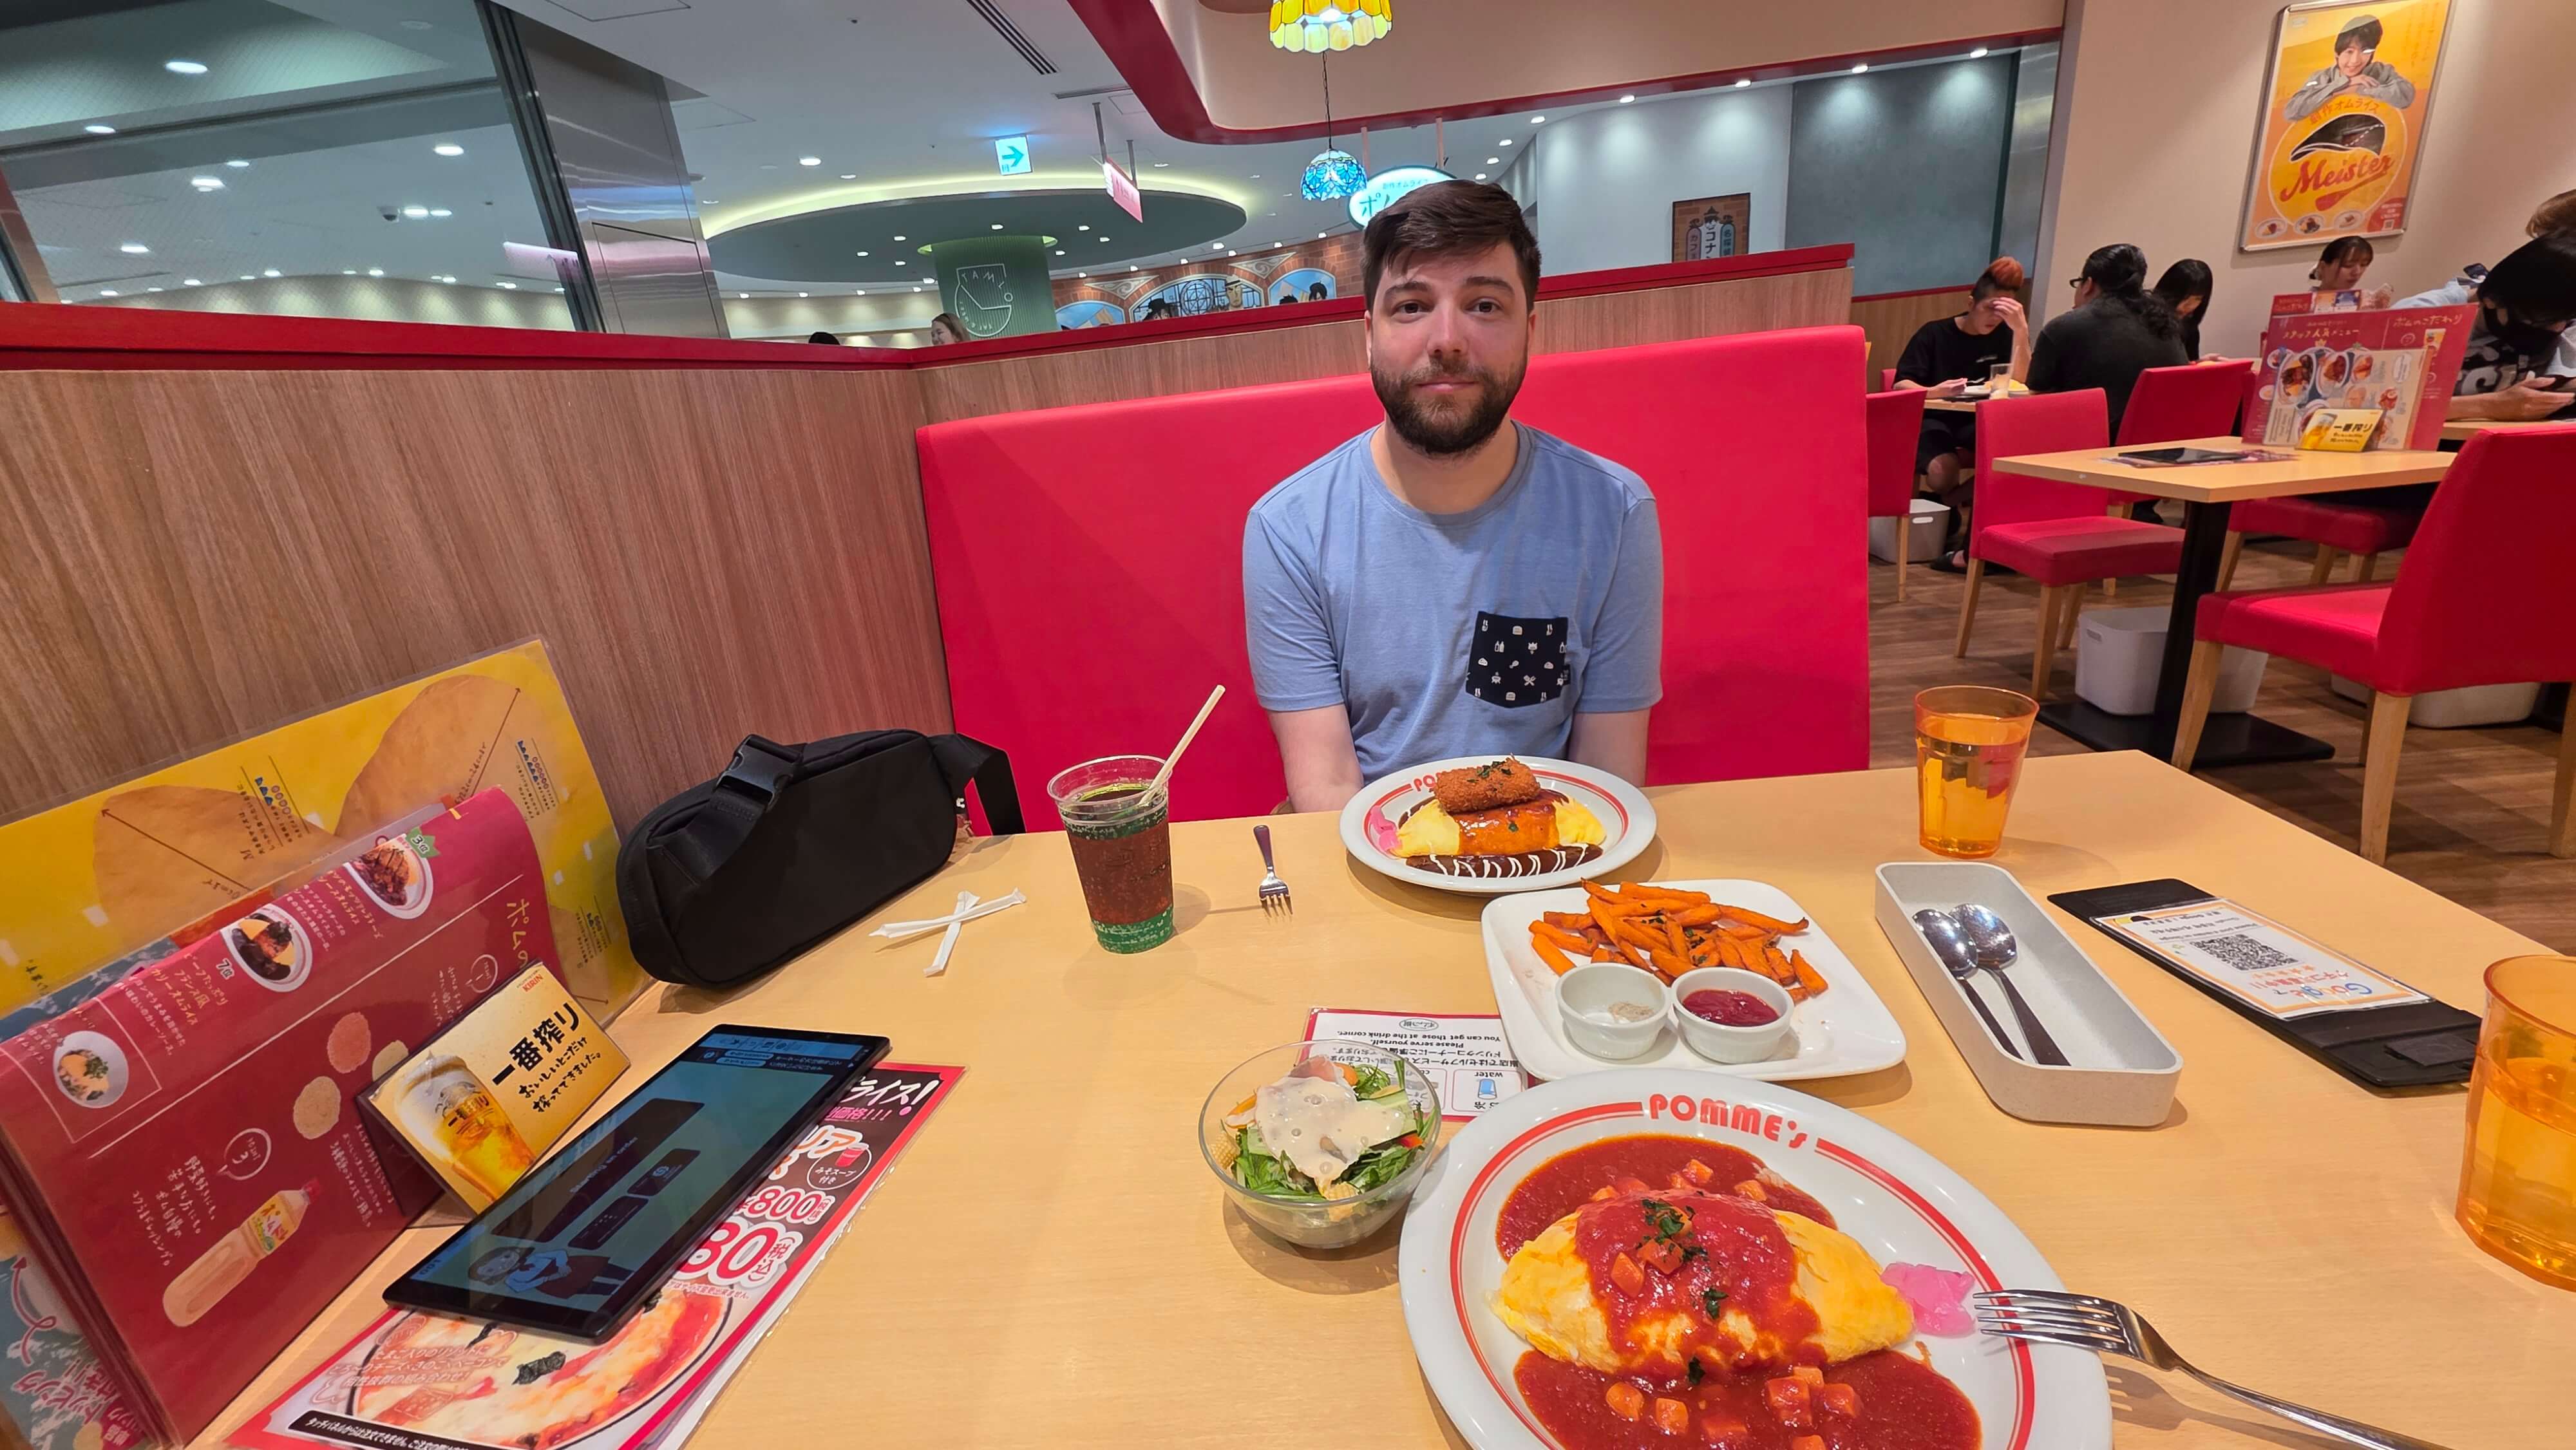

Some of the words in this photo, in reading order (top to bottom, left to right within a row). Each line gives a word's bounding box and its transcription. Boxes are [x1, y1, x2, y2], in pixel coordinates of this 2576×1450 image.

[2280, 153, 2396, 202] Meister
[412, 834, 430, 853] 3位
[174, 968, 210, 1008] フランス風
[184, 952, 229, 1007] ビーフたっぷり
[216, 959, 236, 979] 7位
[522, 974, 544, 992] KIRIN
[151, 968, 198, 1026] カリーオムライス
[491, 1001, 582, 1086] 一番搾り
[516, 1034, 589, 1099] おいしいとこだけ
[530, 1048, 602, 1113] 搾ってできました。
[814, 1166, 857, 1178] みそスープ
[818, 1174, 837, 1186] 付き
